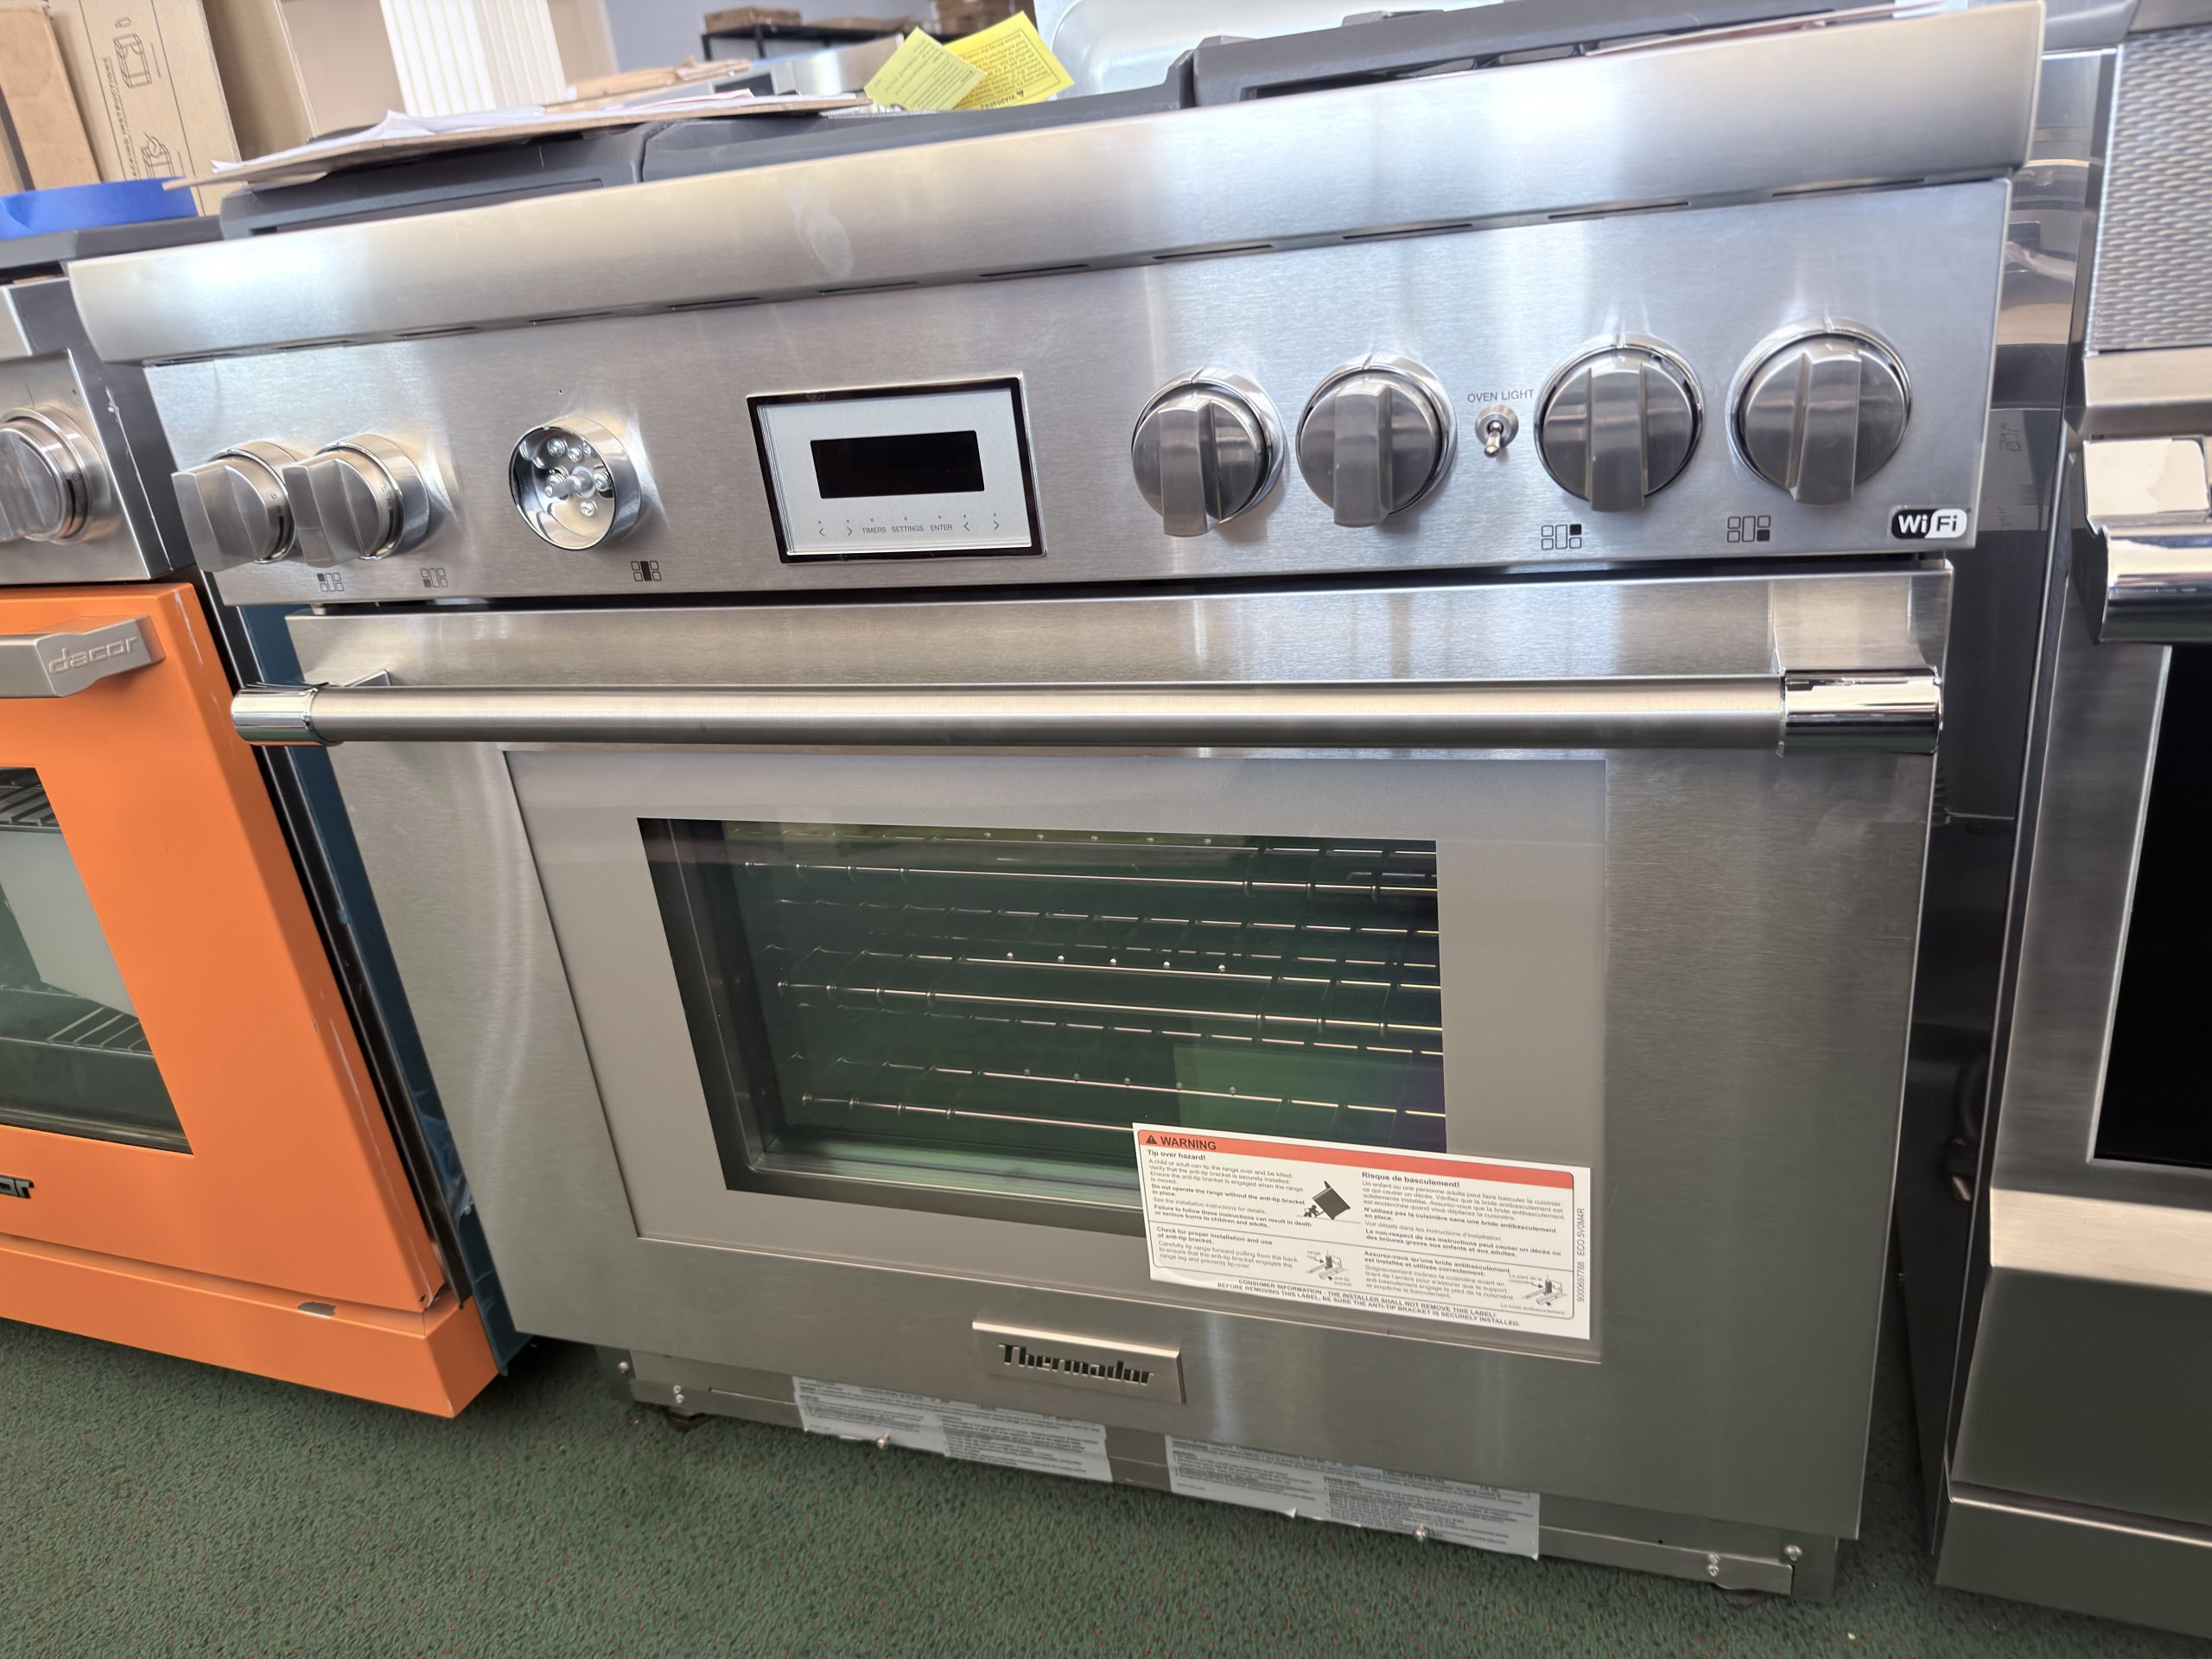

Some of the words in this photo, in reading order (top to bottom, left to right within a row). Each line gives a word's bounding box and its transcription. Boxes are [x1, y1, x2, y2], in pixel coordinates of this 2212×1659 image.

[1467, 392, 1498, 404] OVEN
[1502, 390, 1535, 401] LIGHT
[891, 524, 925, 533] SETTINGS
[930, 524, 953, 532] ENTER
[48, 636, 139, 674] dacor
[1160, 1135, 1217, 1151] WARNING
[1362, 1171, 1390, 1181] Risque
[1403, 1175, 1459, 1187] basculement!
[1576, 1239, 1586, 1256] ECO
[997, 1343, 1154, 1386] Thermador
